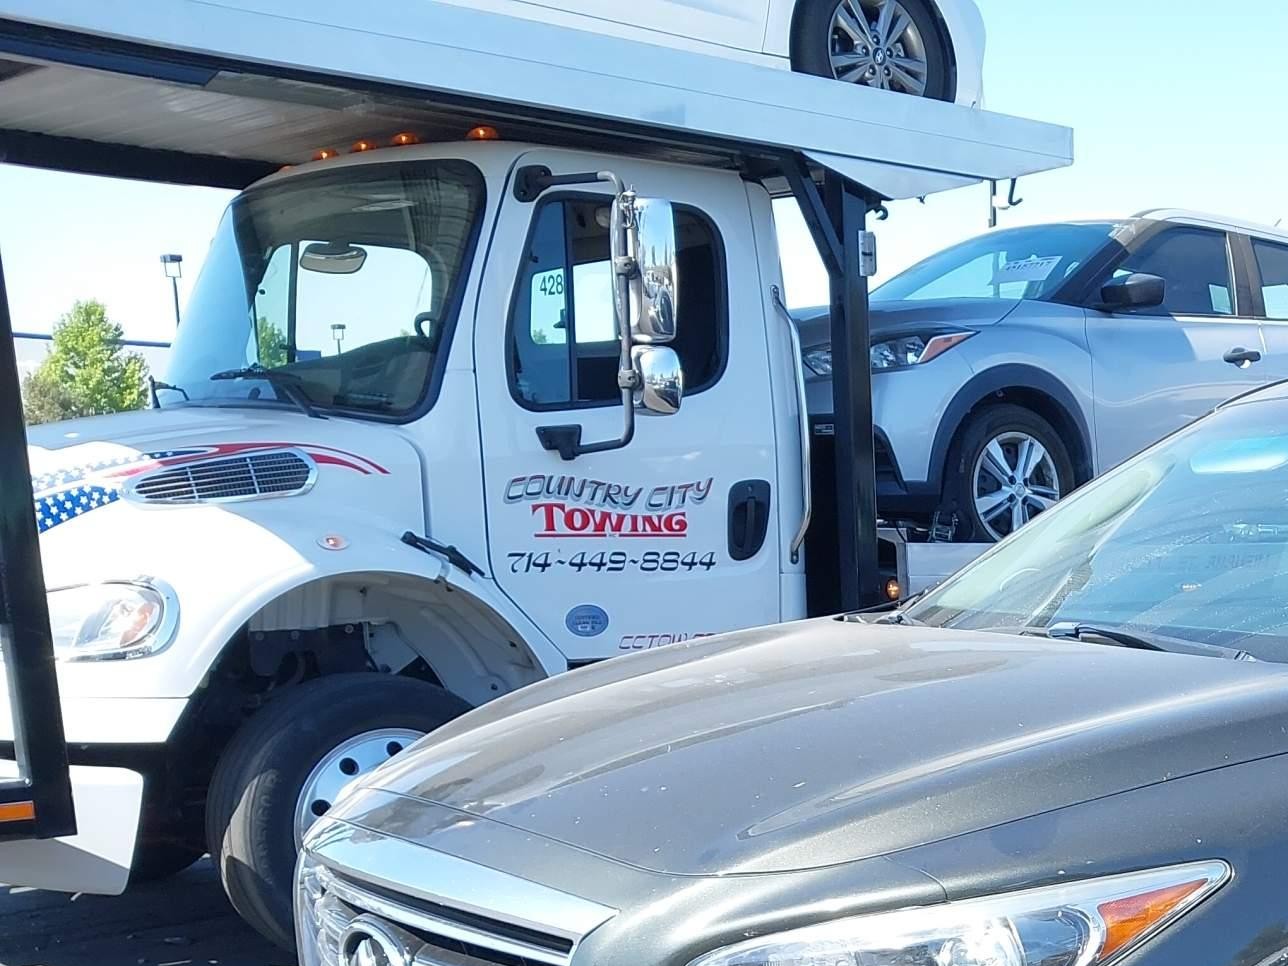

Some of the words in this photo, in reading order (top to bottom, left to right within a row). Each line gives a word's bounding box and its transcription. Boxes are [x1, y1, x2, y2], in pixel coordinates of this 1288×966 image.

[539, 274, 564, 296] 428
[505, 474, 644, 507] COUNTRY
[647, 477, 714, 508] CITY
[531, 502, 688, 533] TOWING
